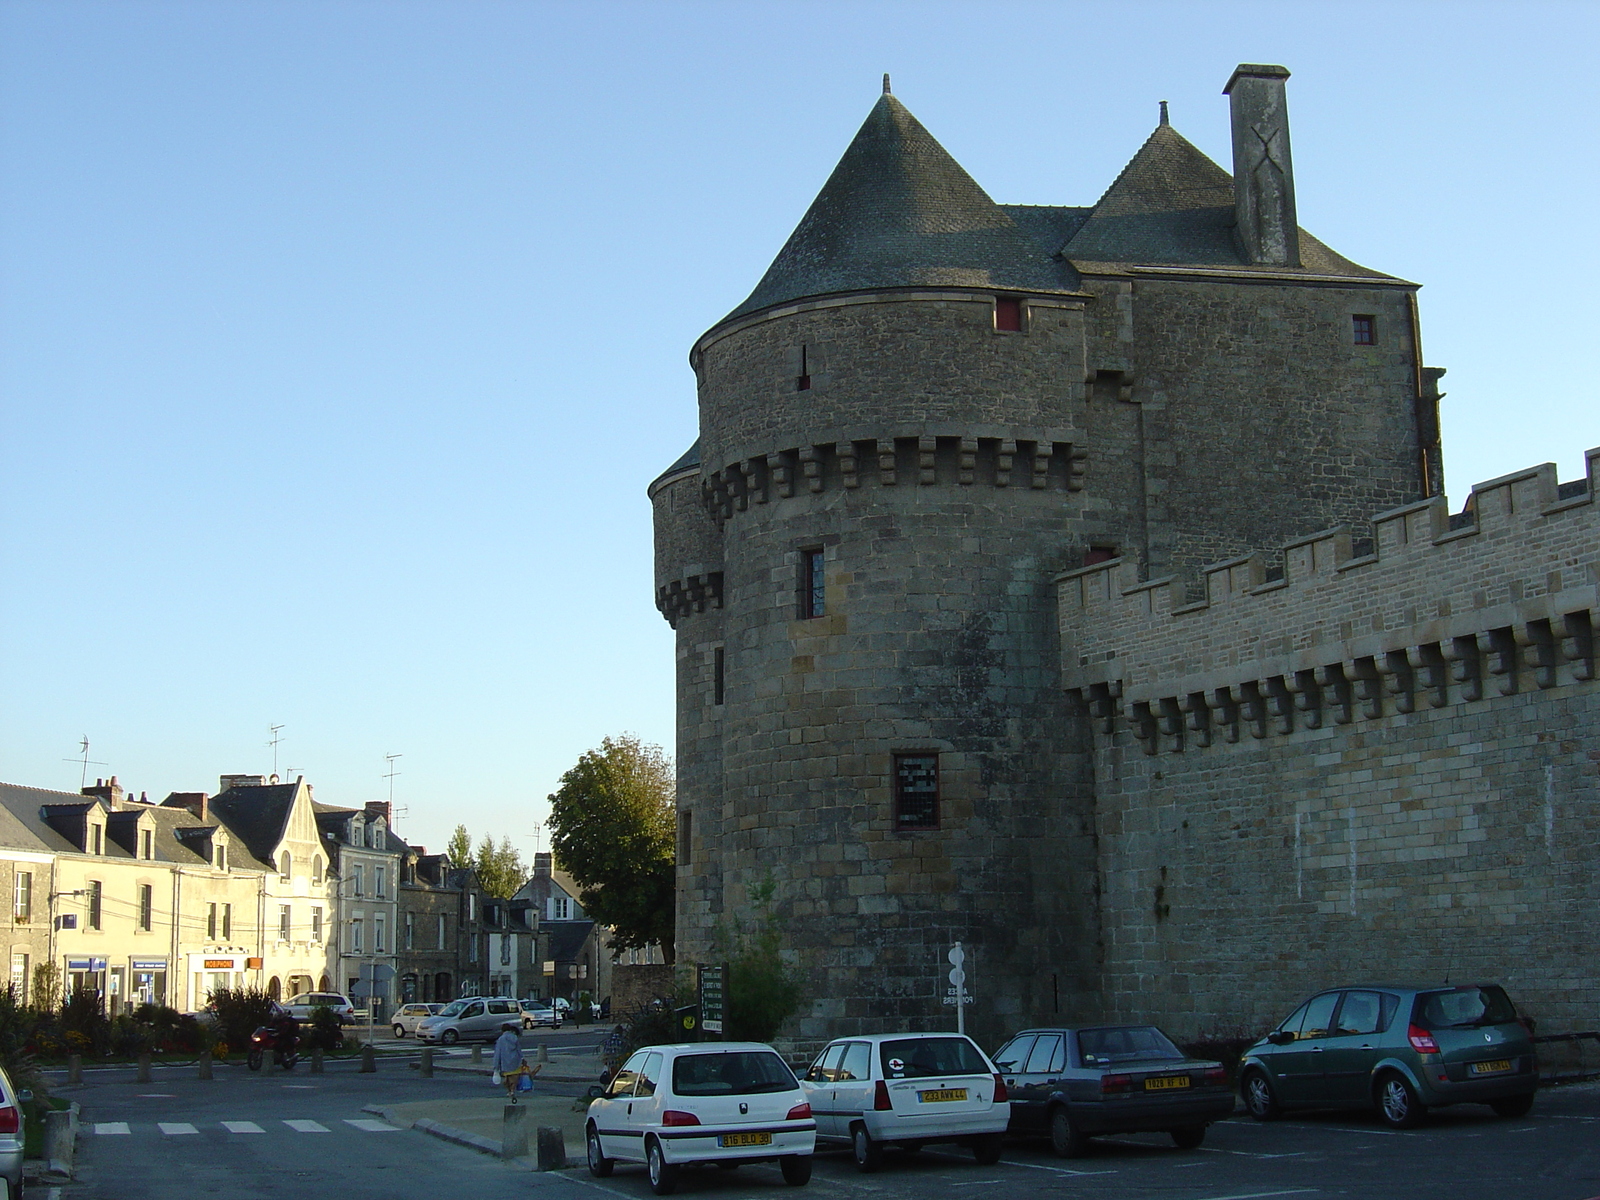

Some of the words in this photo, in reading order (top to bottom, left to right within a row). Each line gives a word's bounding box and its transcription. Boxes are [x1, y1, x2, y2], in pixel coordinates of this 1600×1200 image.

[924, 1091, 939, 1101] 233
[955, 1090, 964, 1098] 44
[723, 1135, 739, 1145] 816
[759, 1133, 769, 1143] 38
